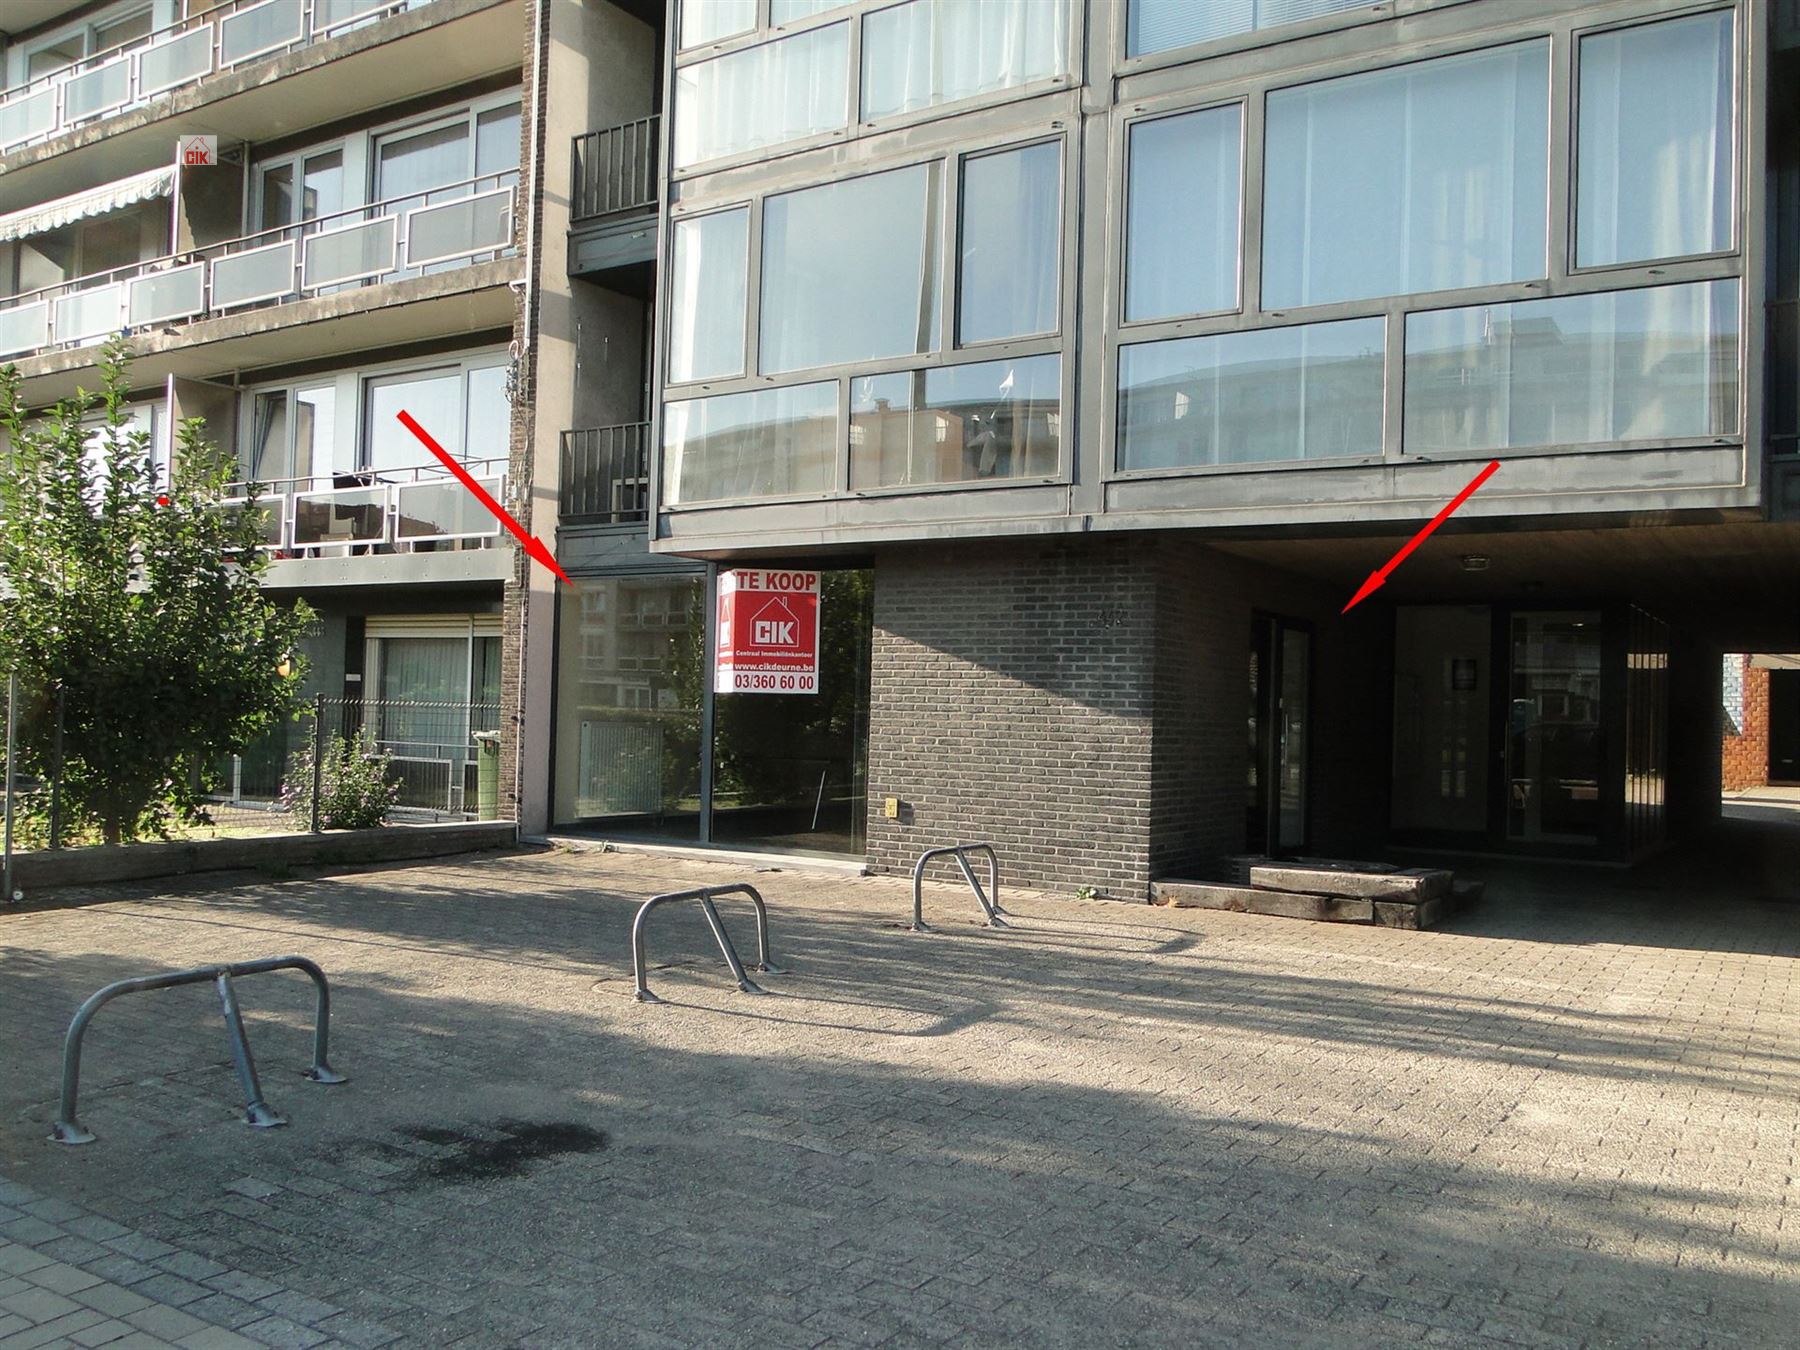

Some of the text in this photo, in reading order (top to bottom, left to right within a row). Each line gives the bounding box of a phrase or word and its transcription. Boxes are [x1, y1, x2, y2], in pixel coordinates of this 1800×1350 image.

[736, 571, 816, 591] TE KOOP
[755, 620, 795, 644] CIK
[734, 662, 814, 672] www.cikdeurne.be
[735, 674, 814, 690] 03/360 60 00
